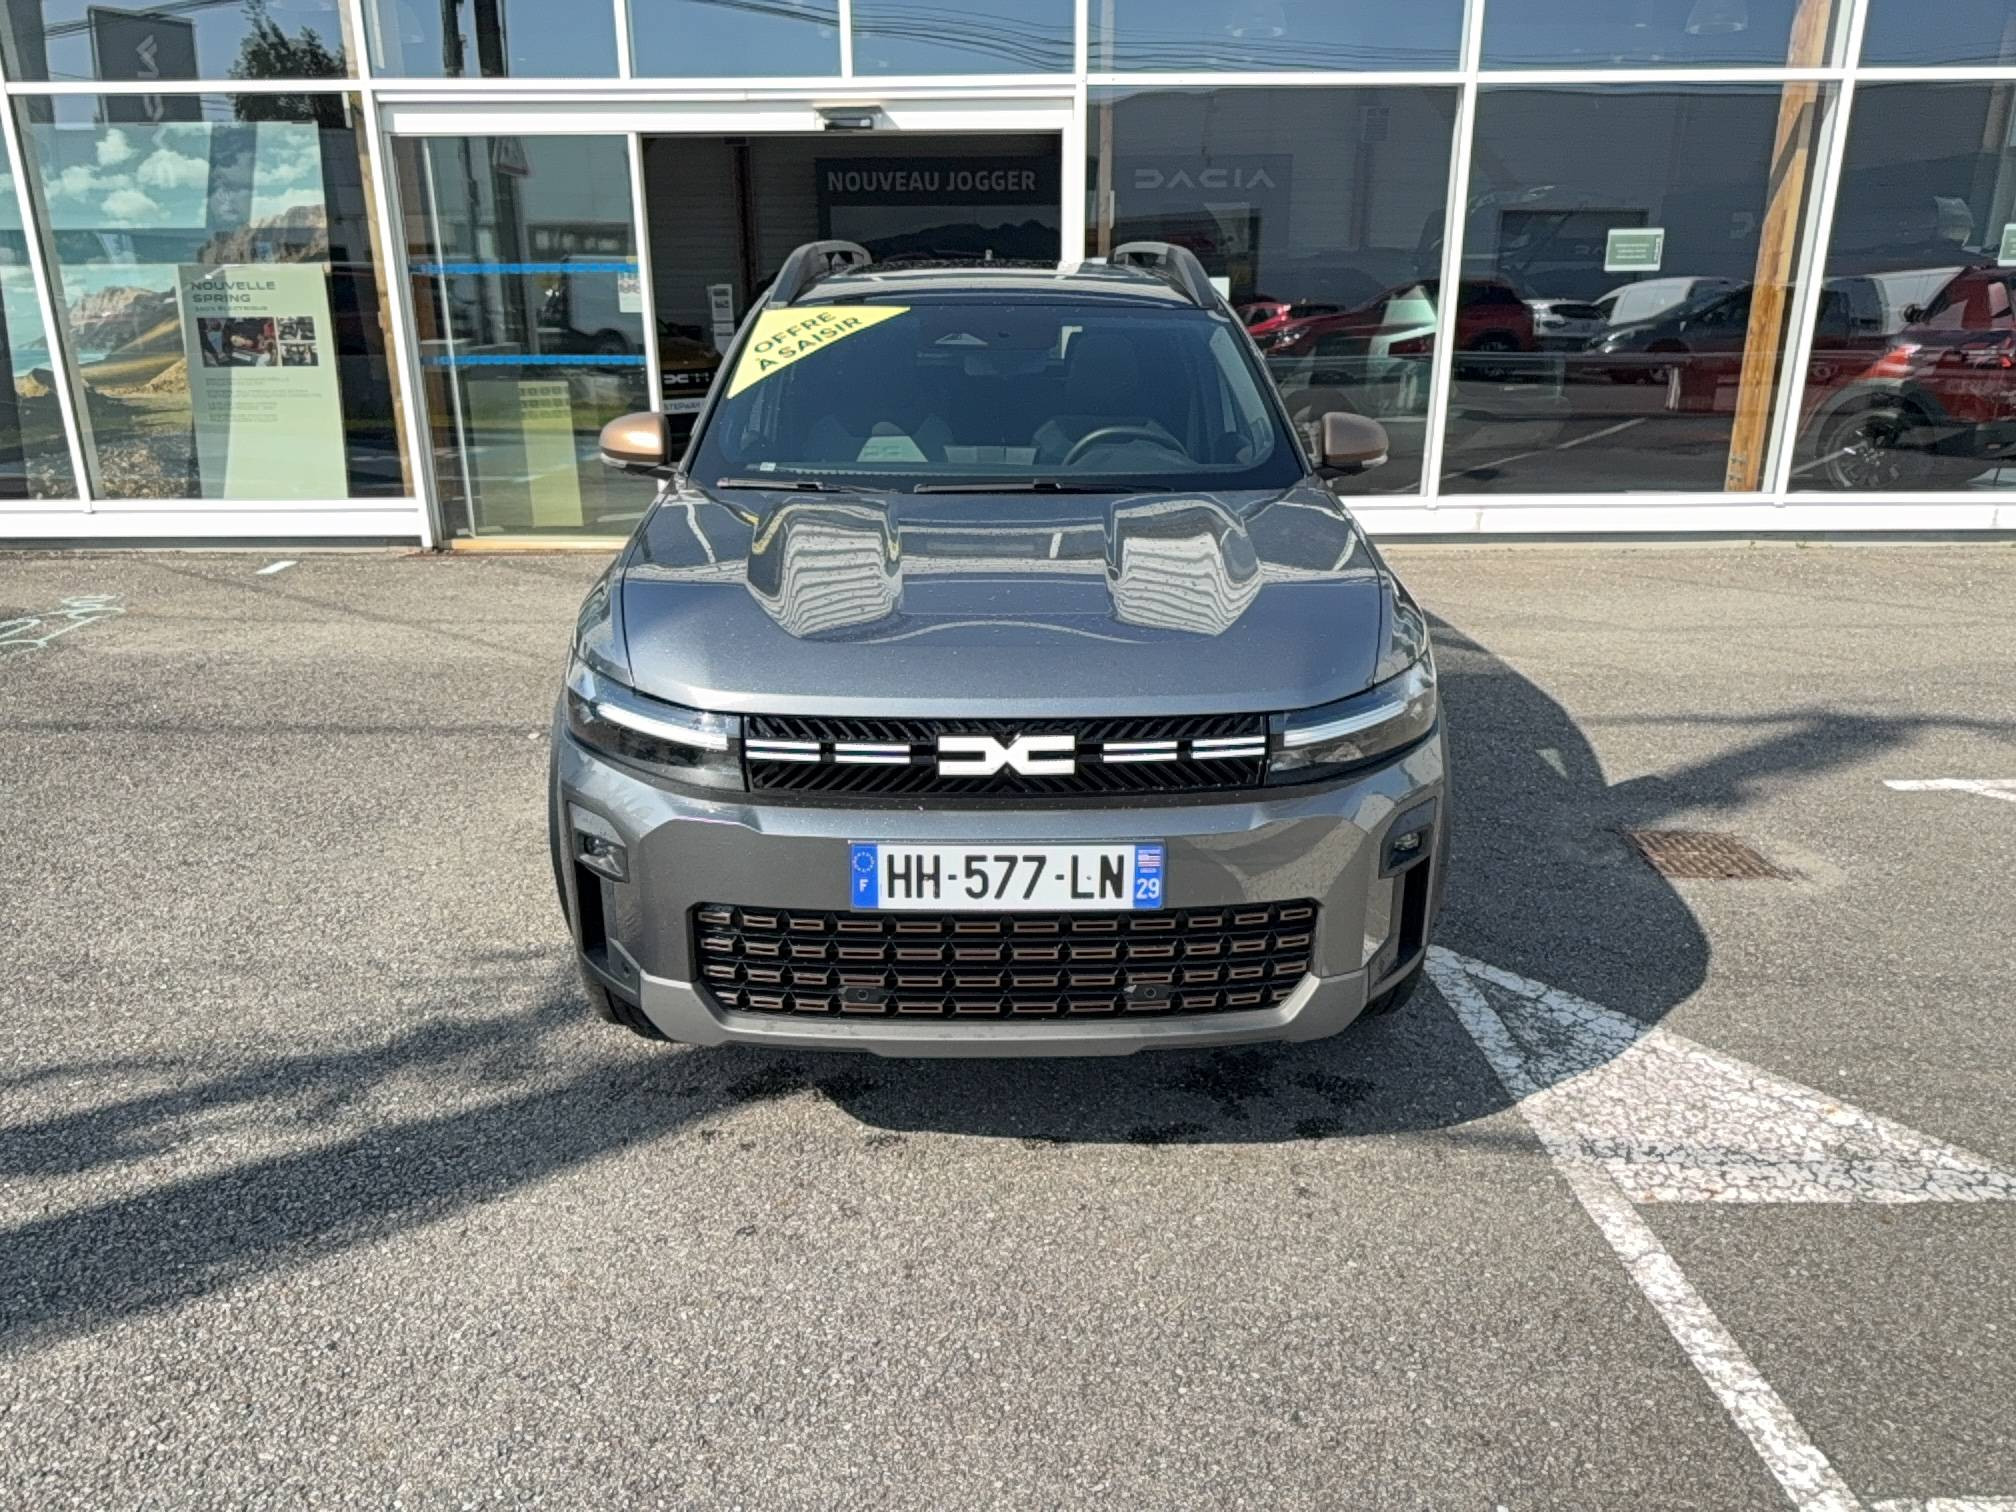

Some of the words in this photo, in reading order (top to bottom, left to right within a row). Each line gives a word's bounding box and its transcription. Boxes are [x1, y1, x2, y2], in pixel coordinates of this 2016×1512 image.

[827, 171, 940, 192] NOUVEAU
[946, 170, 1036, 191] JOGGER
[1134, 167, 1276, 189] DACIA
[190, 280, 276, 291] NOUVELLE
[192, 293, 251, 303] SPRING
[754, 311, 837, 353] OFFRE
[778, 316, 863, 359] SAISIR
[859, 879, 868, 893] F
[886, 854, 1125, 899] HH-577-LN
[1136, 878, 1160, 899] 29
